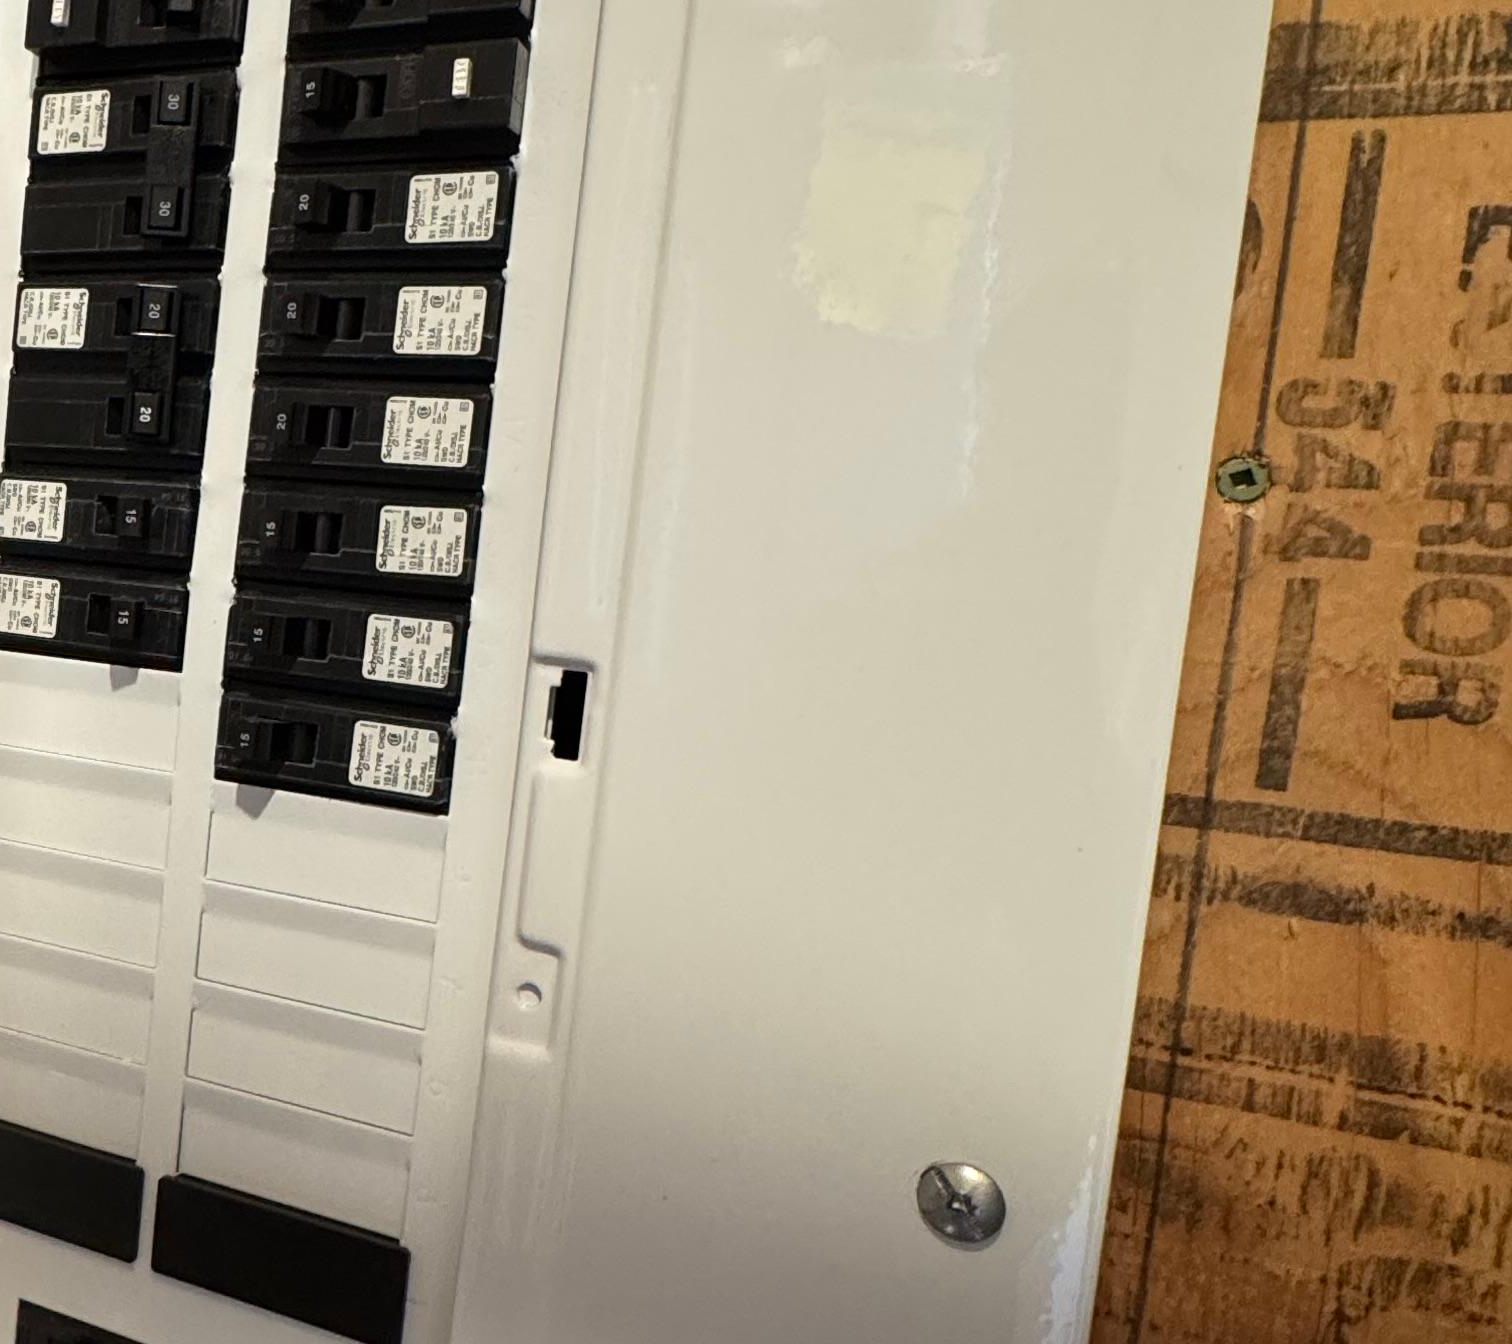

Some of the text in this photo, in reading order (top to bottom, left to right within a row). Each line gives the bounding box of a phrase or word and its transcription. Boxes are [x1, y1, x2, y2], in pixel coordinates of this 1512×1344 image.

[305, 81, 315, 98] 15
[168, 94, 180, 110] 30
[159, 201, 171, 217] 30
[298, 194, 309, 211] 20
[408, 188, 425, 240] Schneider
[148, 303, 161, 319] 20
[287, 302, 297, 319] 20
[396, 299, 413, 350] Schneider
[139, 407, 151, 423] 20
[276, 413, 287, 430] 20
[382, 409, 399, 459] Schneider
[125, 509, 136, 524] 15
[265, 521, 276, 537] 15
[379, 518, 395, 569] Schneider
[118, 611, 129, 625] 15
[253, 627, 263, 642] 15
[367, 626, 383, 676] Schneider
[240, 733, 250, 748] 15
[354, 732, 370, 782] Schneider
